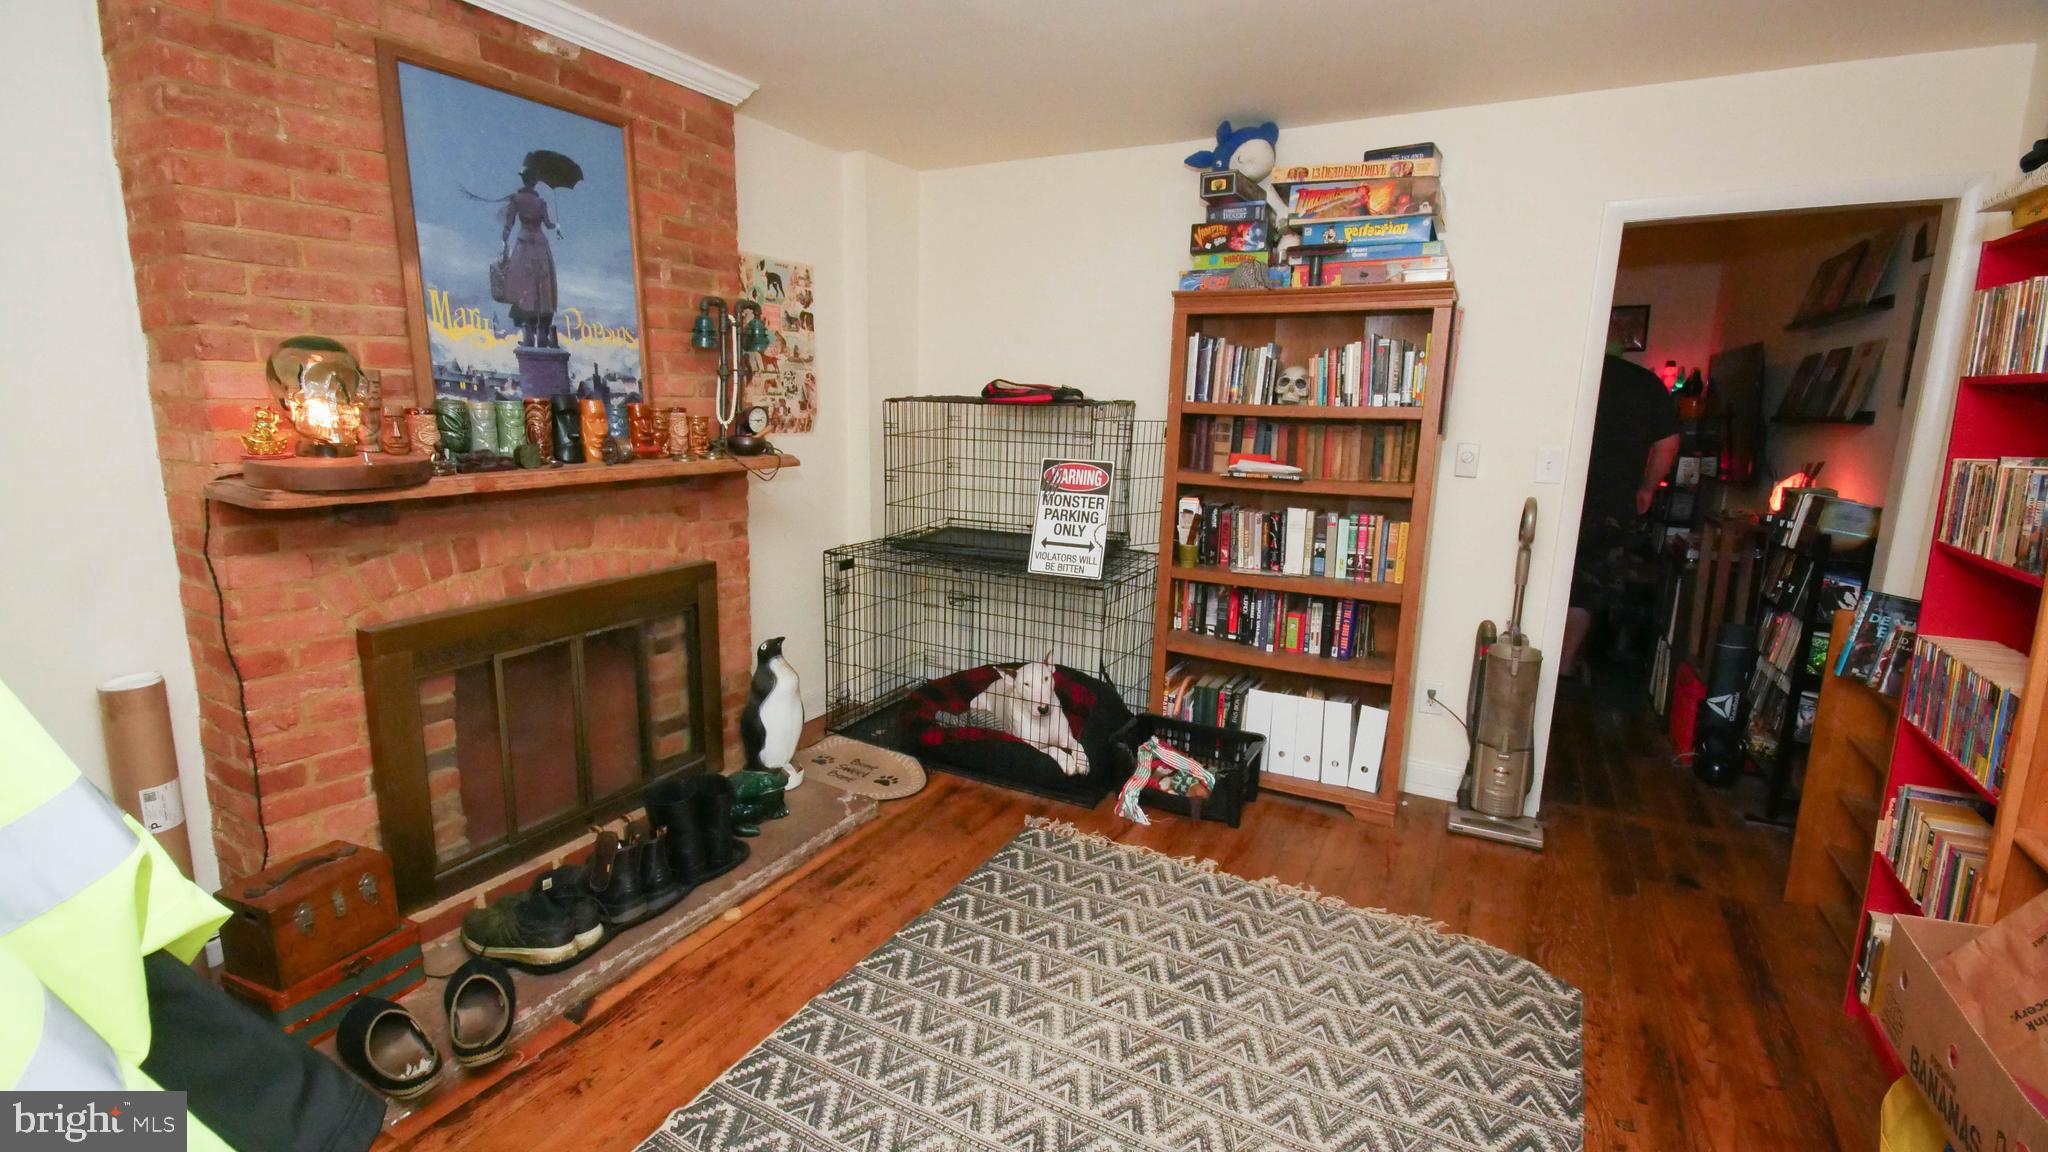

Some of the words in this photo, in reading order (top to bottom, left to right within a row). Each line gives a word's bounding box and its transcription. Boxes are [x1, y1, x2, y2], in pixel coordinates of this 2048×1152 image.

[428, 287, 494, 338] Mary
[1051, 467, 1103, 487] WARNING
[1041, 491, 1105, 510] MONSTER
[1044, 508, 1099, 524] PARKING
[1053, 523, 1087, 538] ONLY
[1034, 551, 1077, 564] VIOLATORS
[1079, 556, 1098, 566] WILL
[1045, 562, 1056, 571] BE
[1057, 563, 1085, 574] BITTEN
